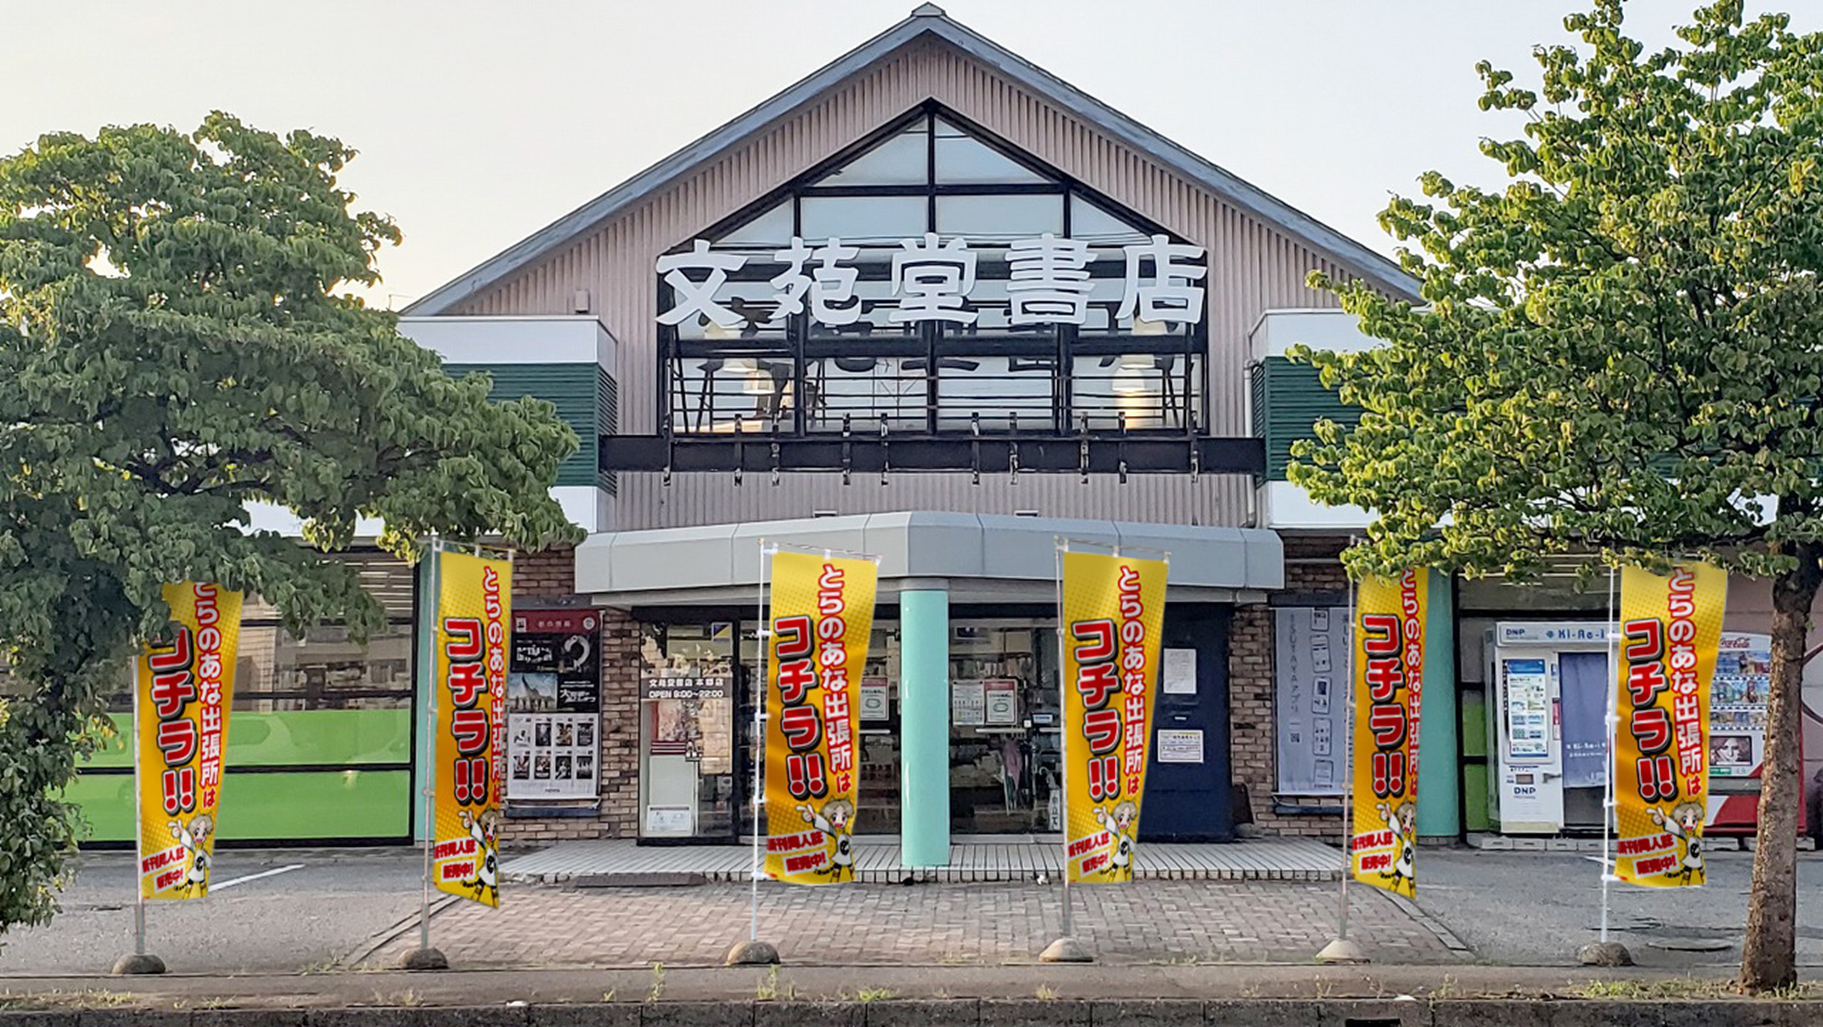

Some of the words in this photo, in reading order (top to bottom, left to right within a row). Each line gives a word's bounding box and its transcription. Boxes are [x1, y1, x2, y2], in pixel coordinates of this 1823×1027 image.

[654, 233, 1207, 327] 文苑堂書店
[444, 617, 489, 806] コチラ!!
[649, 690, 672, 698] OPEN
[774, 614, 828, 800] コチラ!!
[817, 564, 855, 793] とらのあな出張所は
[1071, 618, 1122, 803] コチラ!!
[1117, 565, 1146, 795] とらのあな出張所は
[1362, 614, 1406, 799] コチラ!!
[1624, 617, 1677, 803] コチラ!!
[1668, 566, 1702, 796] とらのあな出張所は
[1513, 787, 1536, 795] DNP
